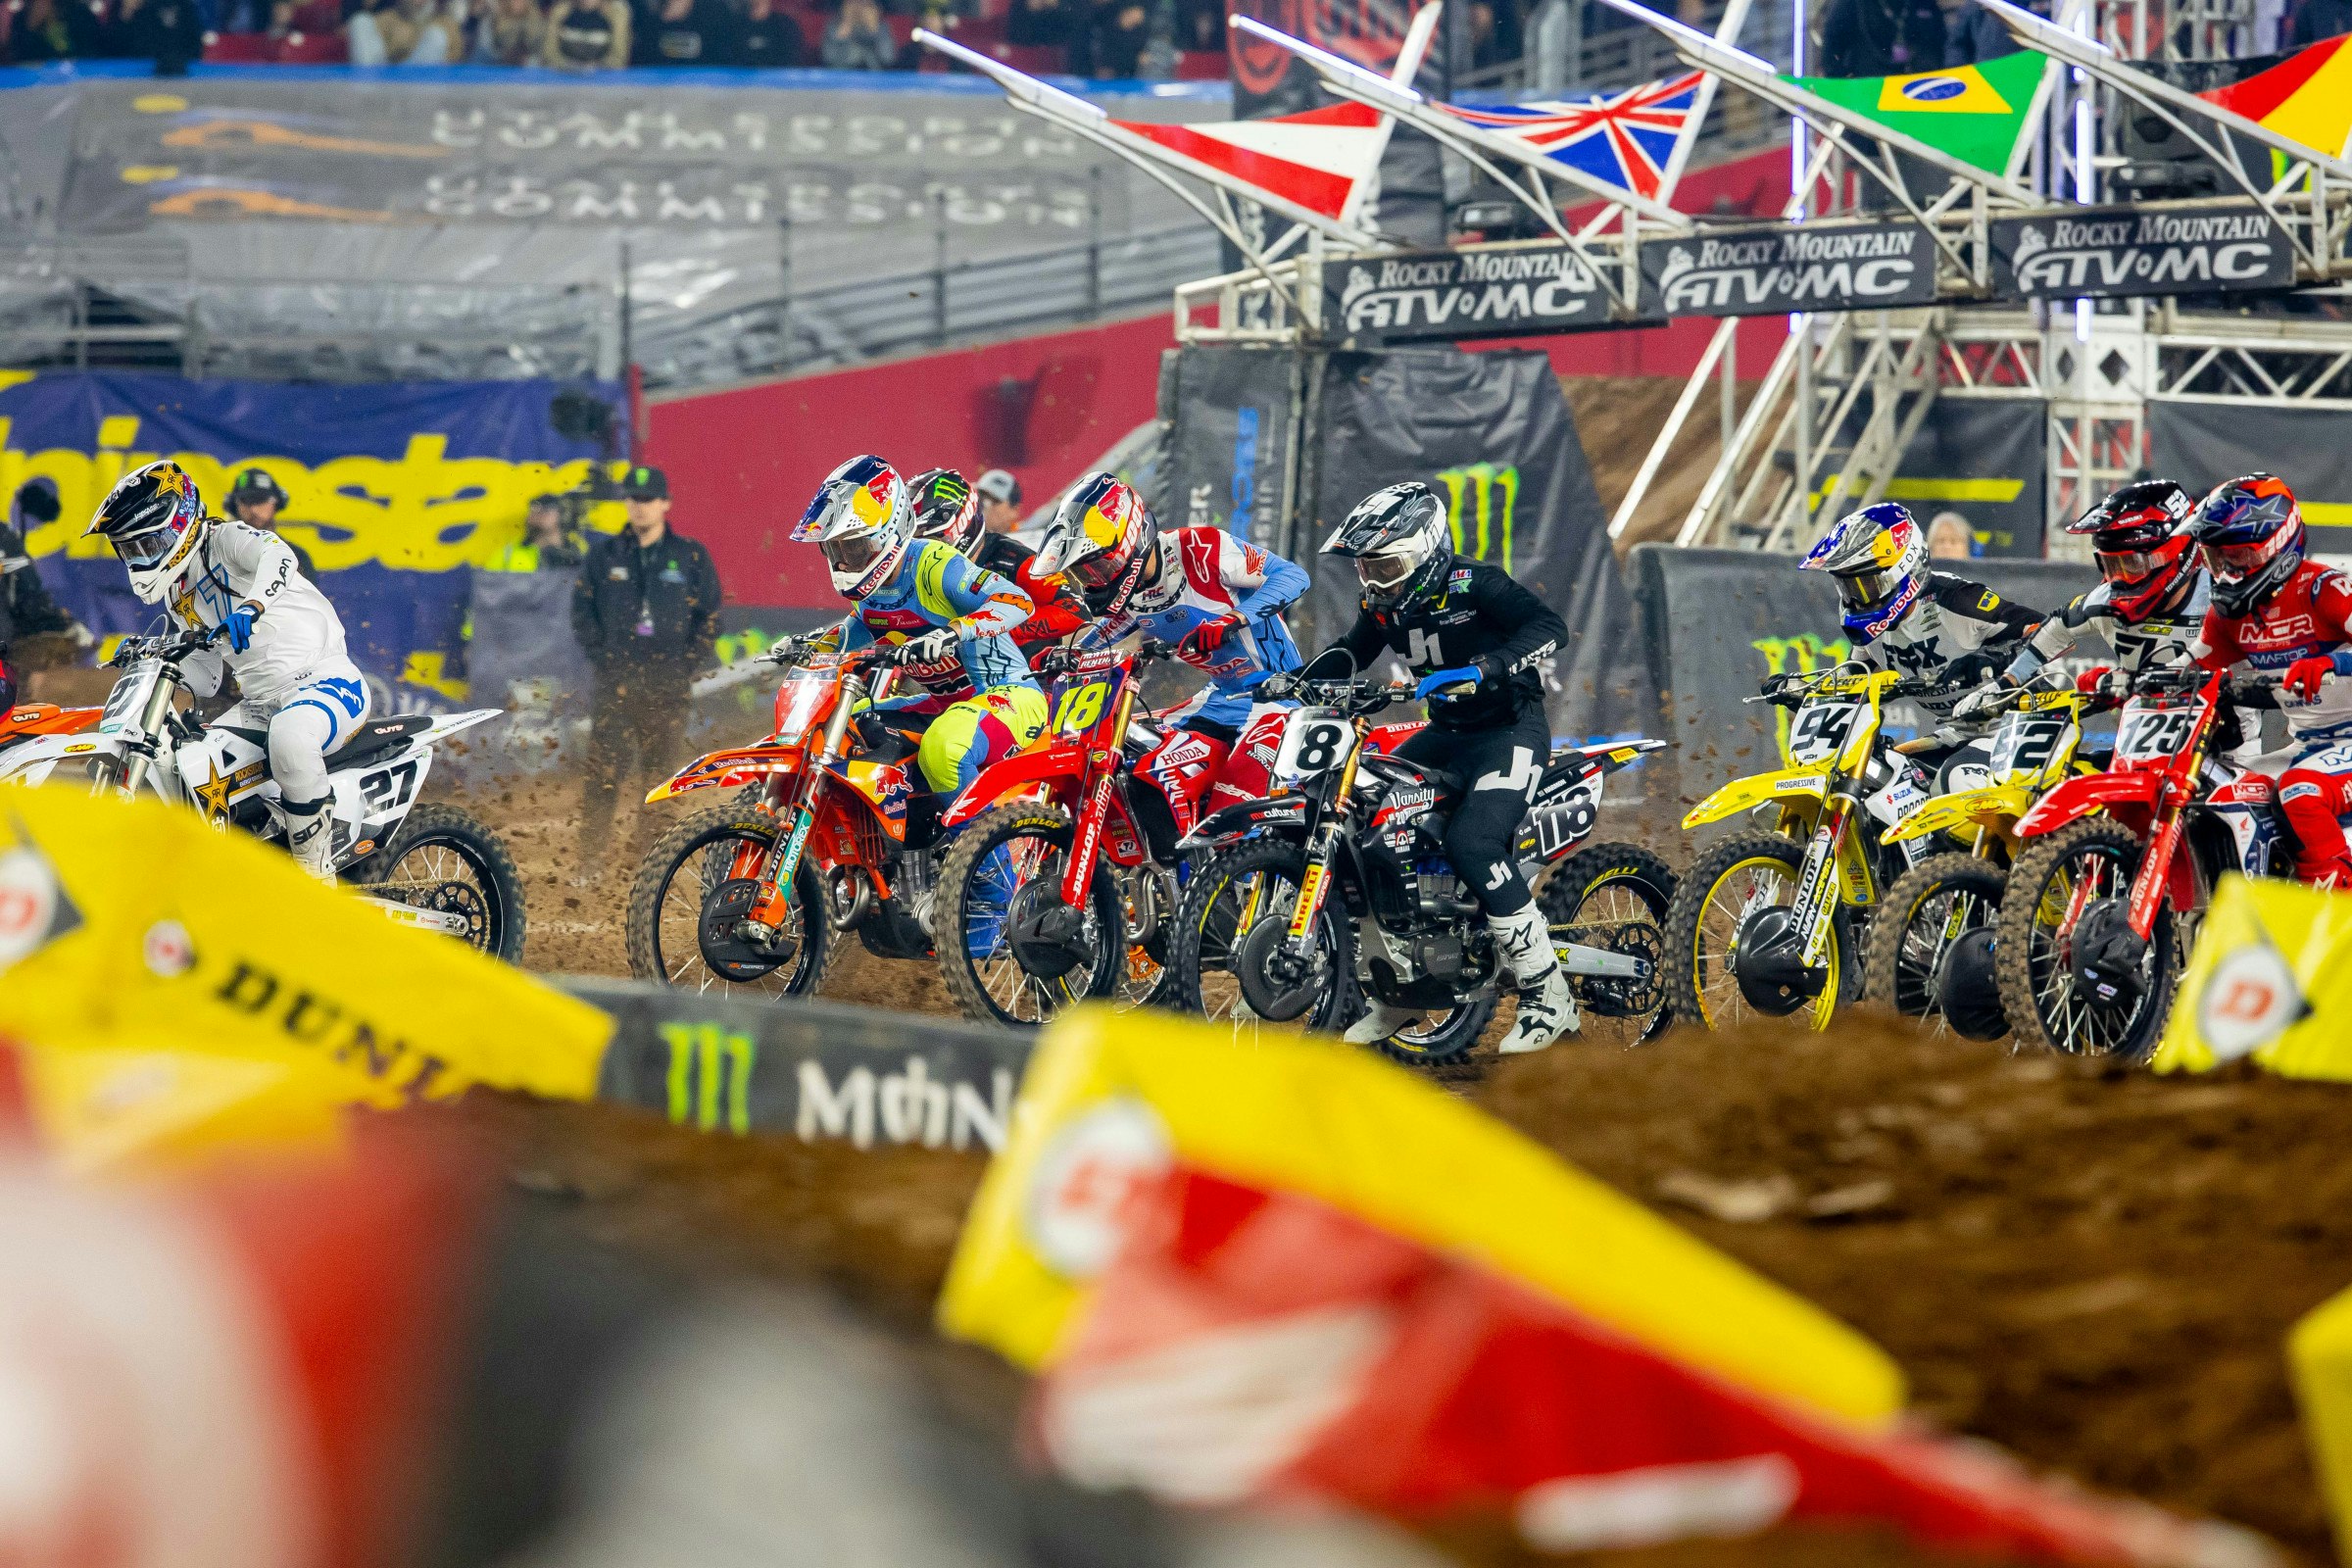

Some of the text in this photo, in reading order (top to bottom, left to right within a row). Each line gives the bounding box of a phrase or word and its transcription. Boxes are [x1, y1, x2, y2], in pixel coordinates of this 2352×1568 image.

[1700, 230, 1916, 270] ROCKY MOUNTAIN
[2052, 215, 2271, 249] ROCKY MOUNTAIN
[1379, 250, 1586, 288] ROCKY MOUNTAIN
[2165, 489, 2191, 519] 52
[1898, 544, 1919, 573] FOX
[2239, 613, 2315, 644] MCR
[13, 711, 40, 723] GUTS
[1053, 682, 1112, 735] 18
[373, 723, 405, 735] GUTS
[1791, 707, 1853, 753] 94
[2117, 713, 2199, 757] 125
[1160, 746, 1206, 765] HONDA
[359, 759, 418, 819] 27
[1158, 768, 1186, 805] CRF
[1776, 777, 1817, 790] PROGRESSIVE
[1015, 817, 1061, 829] DUNLOP
[784, 824, 809, 873] MOTOREX
[1072, 822, 1097, 897] DUNLOP
[1789, 858, 1819, 932] DUNLOP
